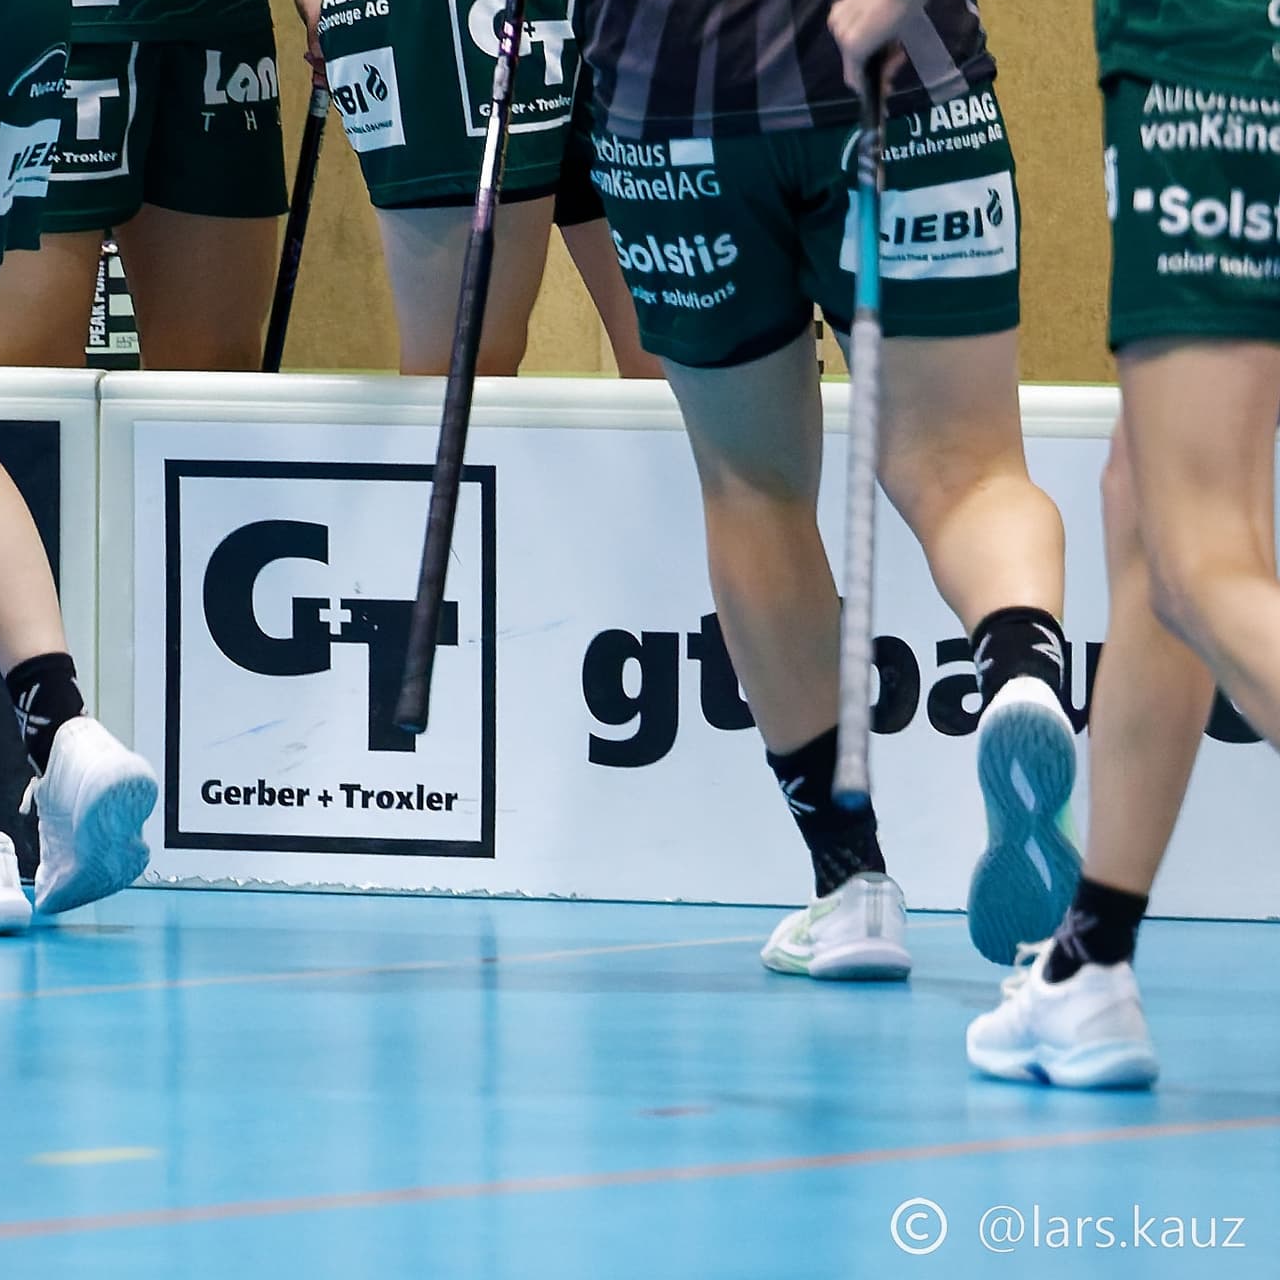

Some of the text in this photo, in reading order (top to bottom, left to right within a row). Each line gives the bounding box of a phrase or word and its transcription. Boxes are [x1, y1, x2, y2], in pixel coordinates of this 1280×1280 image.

[365, 0, 390, 19] AG
[988, 122, 1004, 143] AG
[62, 149, 118, 164] Troxler
[1158, 185, 1280, 242] Sols
[661, 280, 737, 310] solutions
[200, 778, 311, 813] Gerber
[338, 779, 459, 814] Troxler
